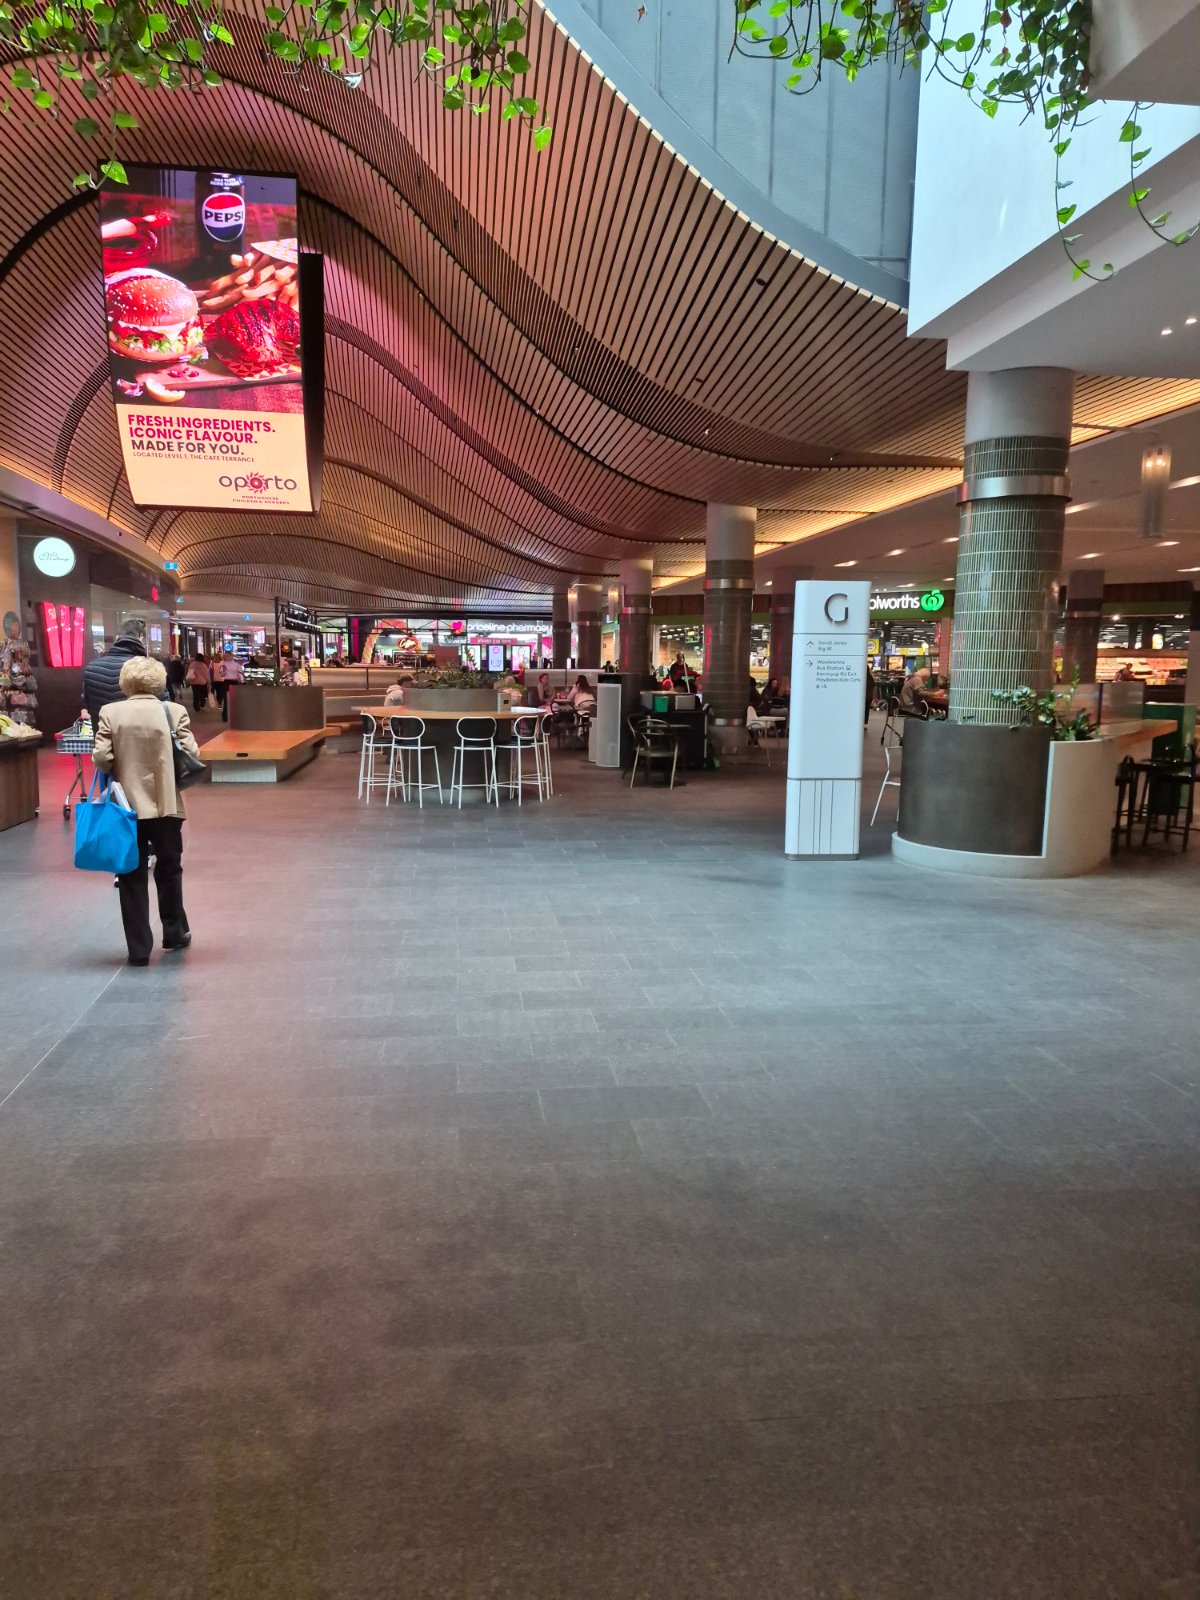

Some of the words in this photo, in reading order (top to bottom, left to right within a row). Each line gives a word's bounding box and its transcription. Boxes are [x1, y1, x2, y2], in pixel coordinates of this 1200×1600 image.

[204, 209, 243, 222] PEPSI
[128, 414, 173, 427] FRESH
[176, 417, 276, 433] INGREDIENTS.
[129, 427, 183, 440] ICONIC
[186, 430, 258, 444] FLAVOUR.
[131, 439, 174, 452] MADE
[177, 442, 206, 454] FOR
[209, 443, 245, 456] YOU.
[218, 473, 297, 493] oporto
[824, 593, 848, 623] G
[506, 622, 553, 635] pharmacy
